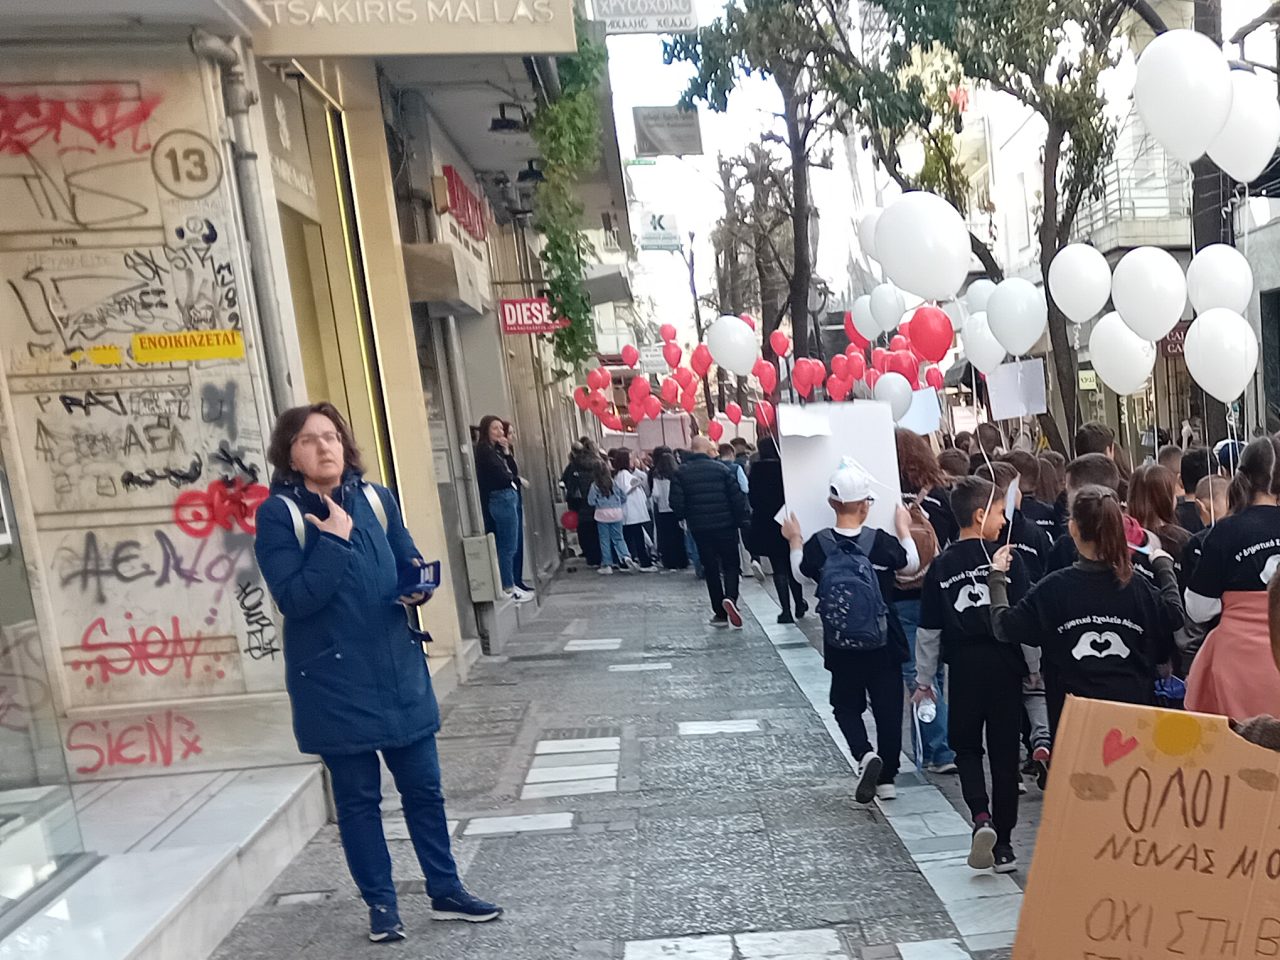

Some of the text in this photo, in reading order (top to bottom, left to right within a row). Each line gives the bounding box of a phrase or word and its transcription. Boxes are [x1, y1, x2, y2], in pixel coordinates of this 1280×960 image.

[270, 1, 554, 24] TSAKIRIS MALLAS
[164, 147, 209, 183] 13
[139, 332, 237, 350] ΕΝΟΙΚΙΑΖΕΤΑΙ
[1122, 766, 1231, 833] ΟΛΟΙ
[1084, 897, 1154, 949] ΟΧΙ
[1166, 910, 1245, 956] ΣΤΗ
